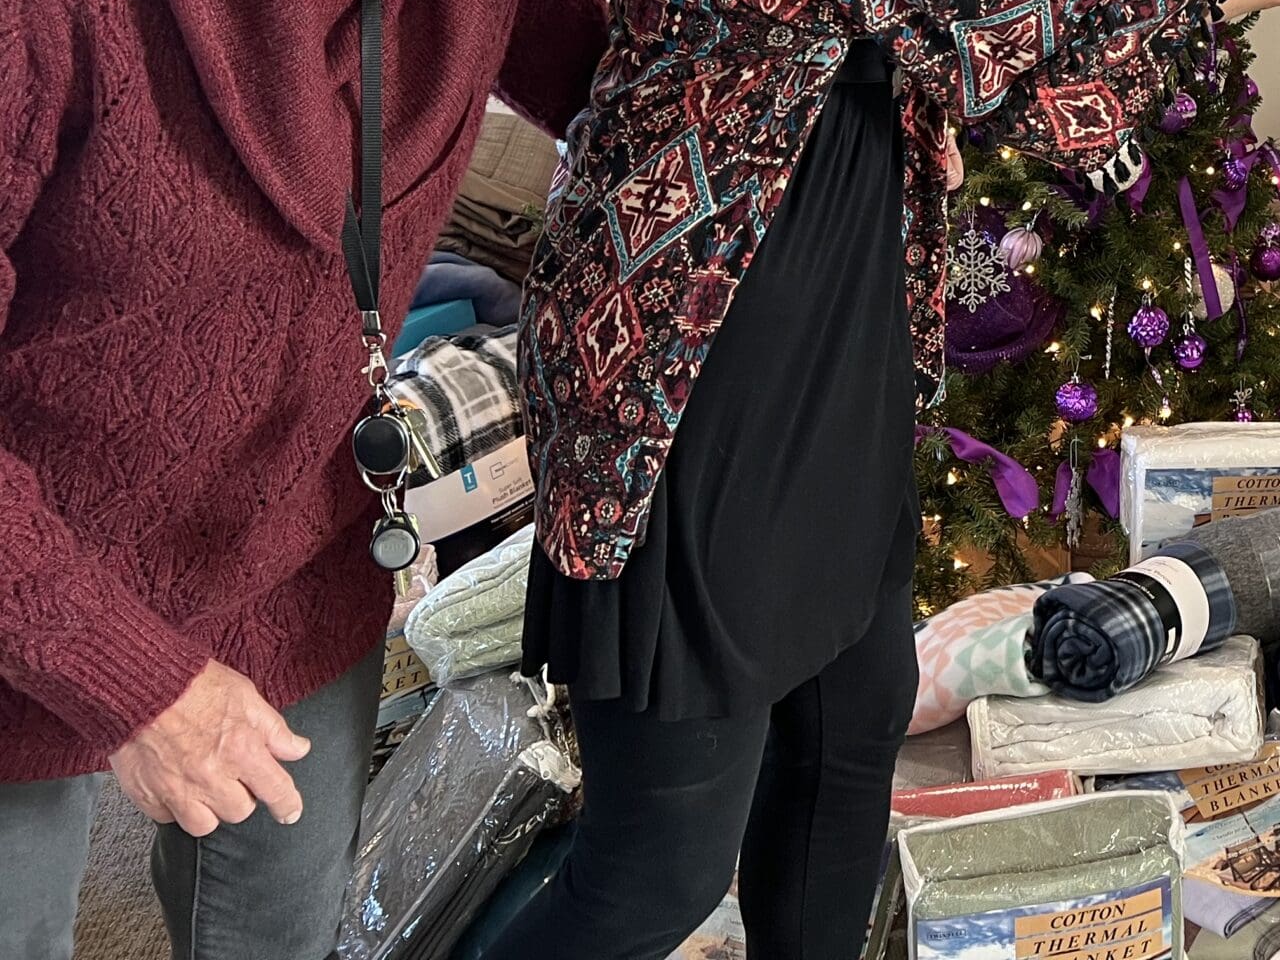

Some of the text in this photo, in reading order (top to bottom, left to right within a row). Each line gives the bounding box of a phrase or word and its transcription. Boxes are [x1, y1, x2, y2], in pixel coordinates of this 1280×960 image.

[463, 471, 473, 484] T
[509, 479, 532, 496] Blanket
[1049, 902, 1126, 930] COTTON
[1032, 919, 1149, 955] THERMAL
